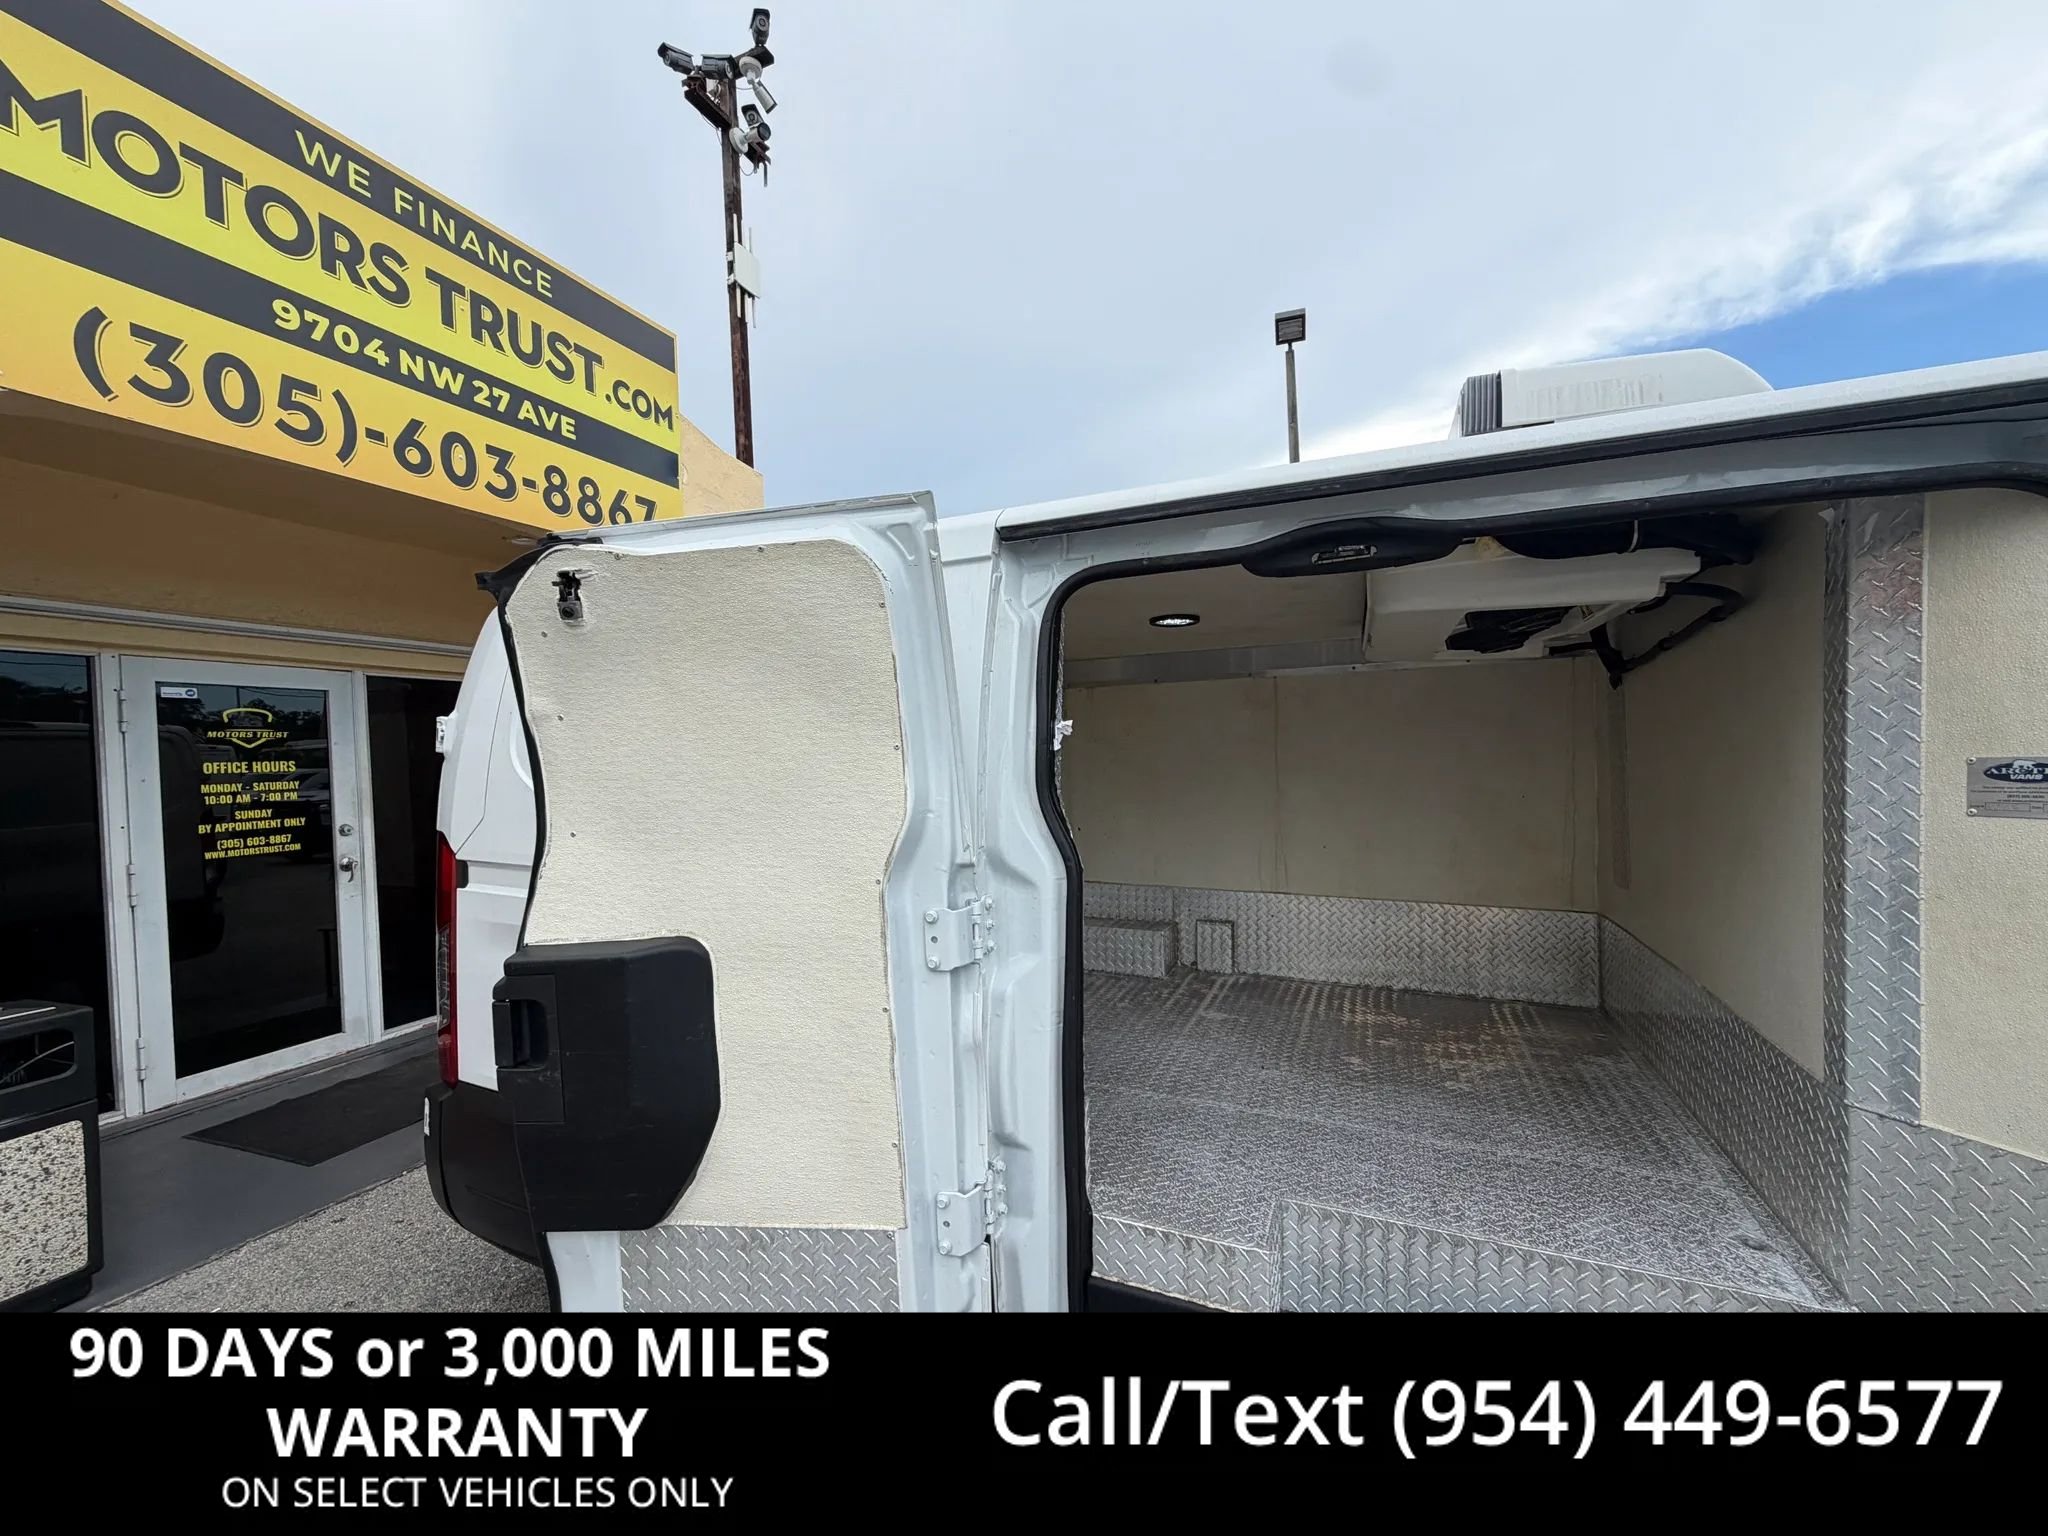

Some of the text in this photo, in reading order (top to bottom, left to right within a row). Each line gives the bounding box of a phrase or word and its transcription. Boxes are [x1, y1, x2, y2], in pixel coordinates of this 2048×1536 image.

[0, 59, 411, 308] MOTORS
[295, 129, 554, 298] WE FINANCE
[272, 298, 578, 441] 9704 NW 27 AVE
[74, 305, 658, 529] (305)-603-8867
[202, 760, 297, 774] OFFICE HOURS
[200, 783, 243, 794] MONDAY
[252, 781, 300, 792] SATURDAY
[204, 795, 233, 805] 10:00
[235, 794, 251, 803] AM
[260, 793, 281, 802] 7:00
[283, 791, 298, 801] PM
[234, 809, 273, 820] SUNDAY
[198, 817, 306, 834] BY APPOINTMENT ONLY
[217, 834, 292, 851] (305) 603-8867
[204, 843, 302, 860] WWW.MOTORSTRUST.COM
